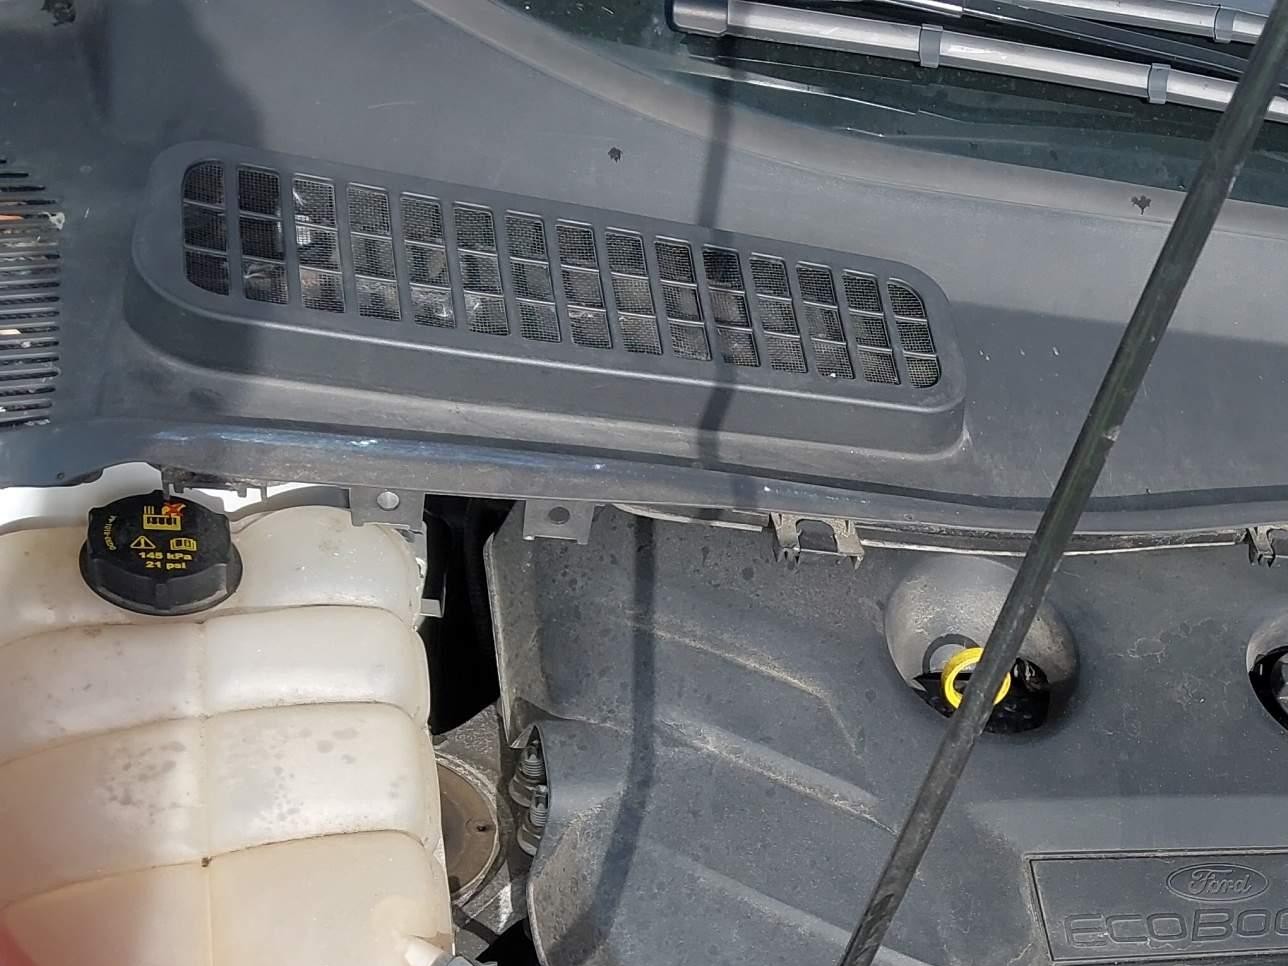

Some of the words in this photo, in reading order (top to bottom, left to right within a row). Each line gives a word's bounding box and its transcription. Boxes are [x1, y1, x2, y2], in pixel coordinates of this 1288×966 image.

[167, 552, 192, 560] kPa
[166, 562, 186, 570] psi
[1188, 868, 1253, 895] Ford
